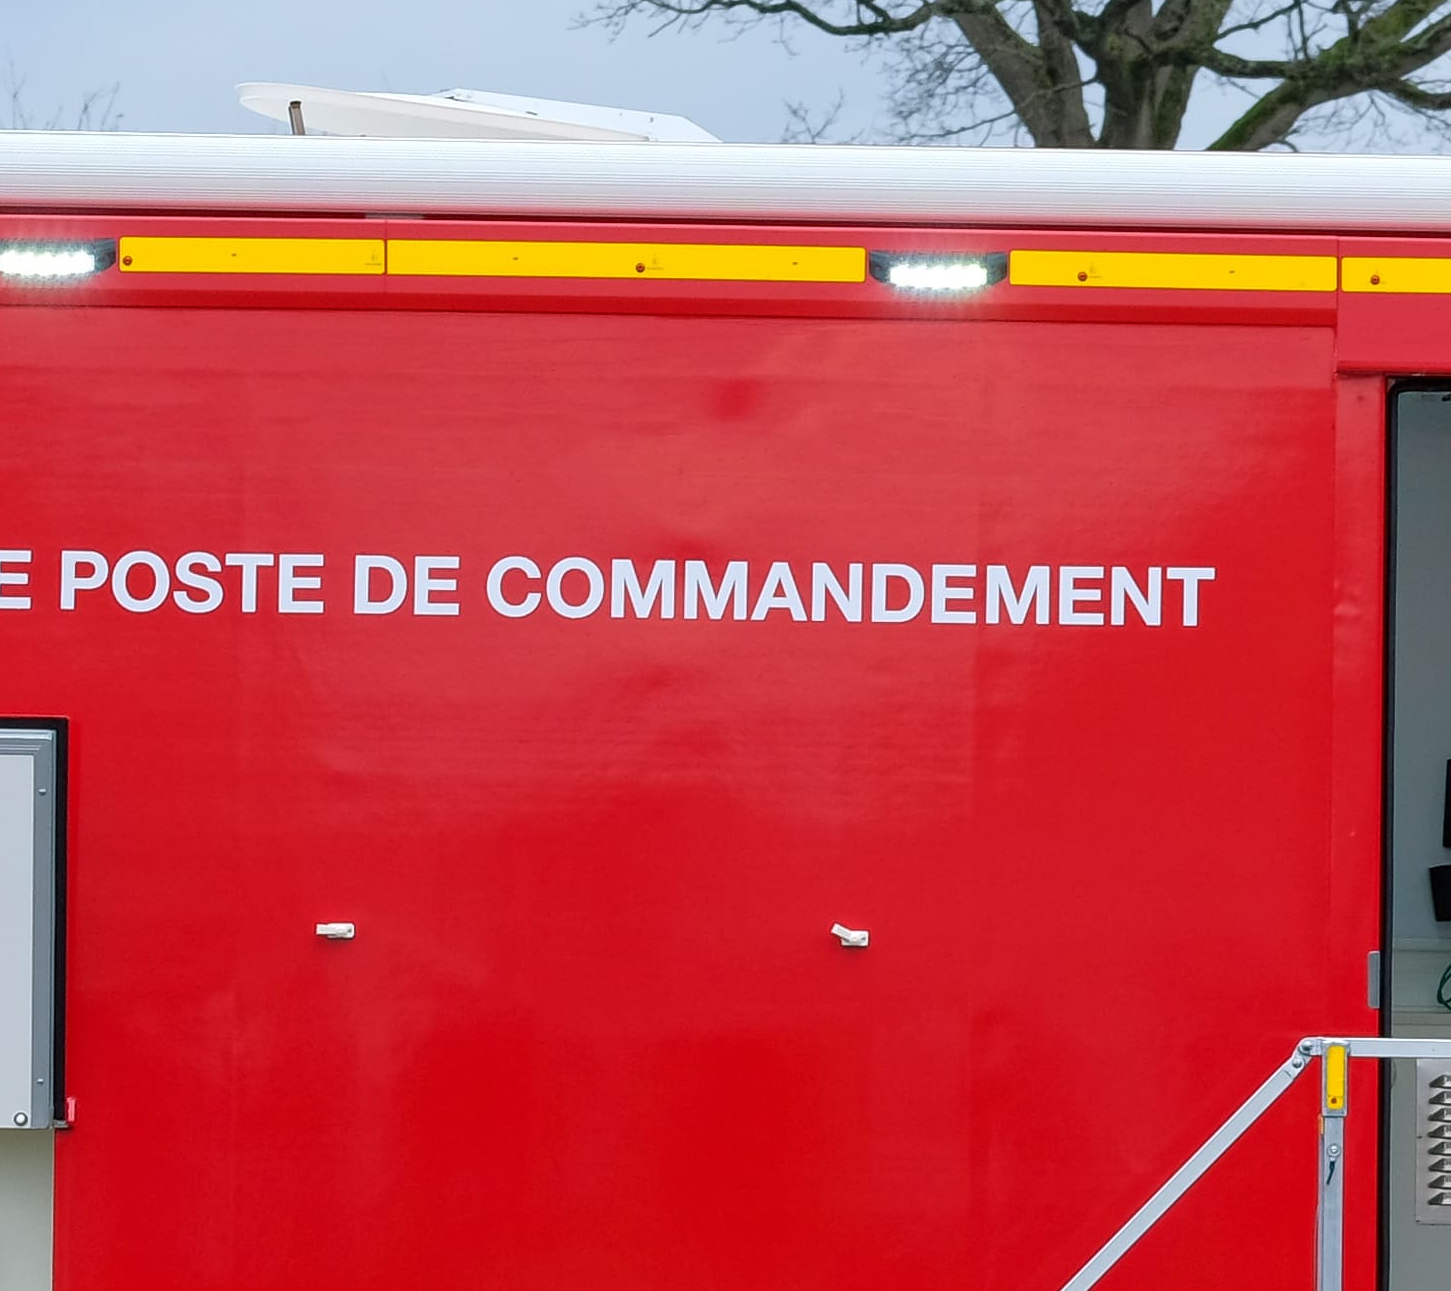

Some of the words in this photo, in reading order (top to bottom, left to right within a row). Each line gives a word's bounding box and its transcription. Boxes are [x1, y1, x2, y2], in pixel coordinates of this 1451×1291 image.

[60, 550, 324, 614] POSTE
[353, 554, 460, 616] DE
[486, 555, 1216, 627] COMMANDEMENT
